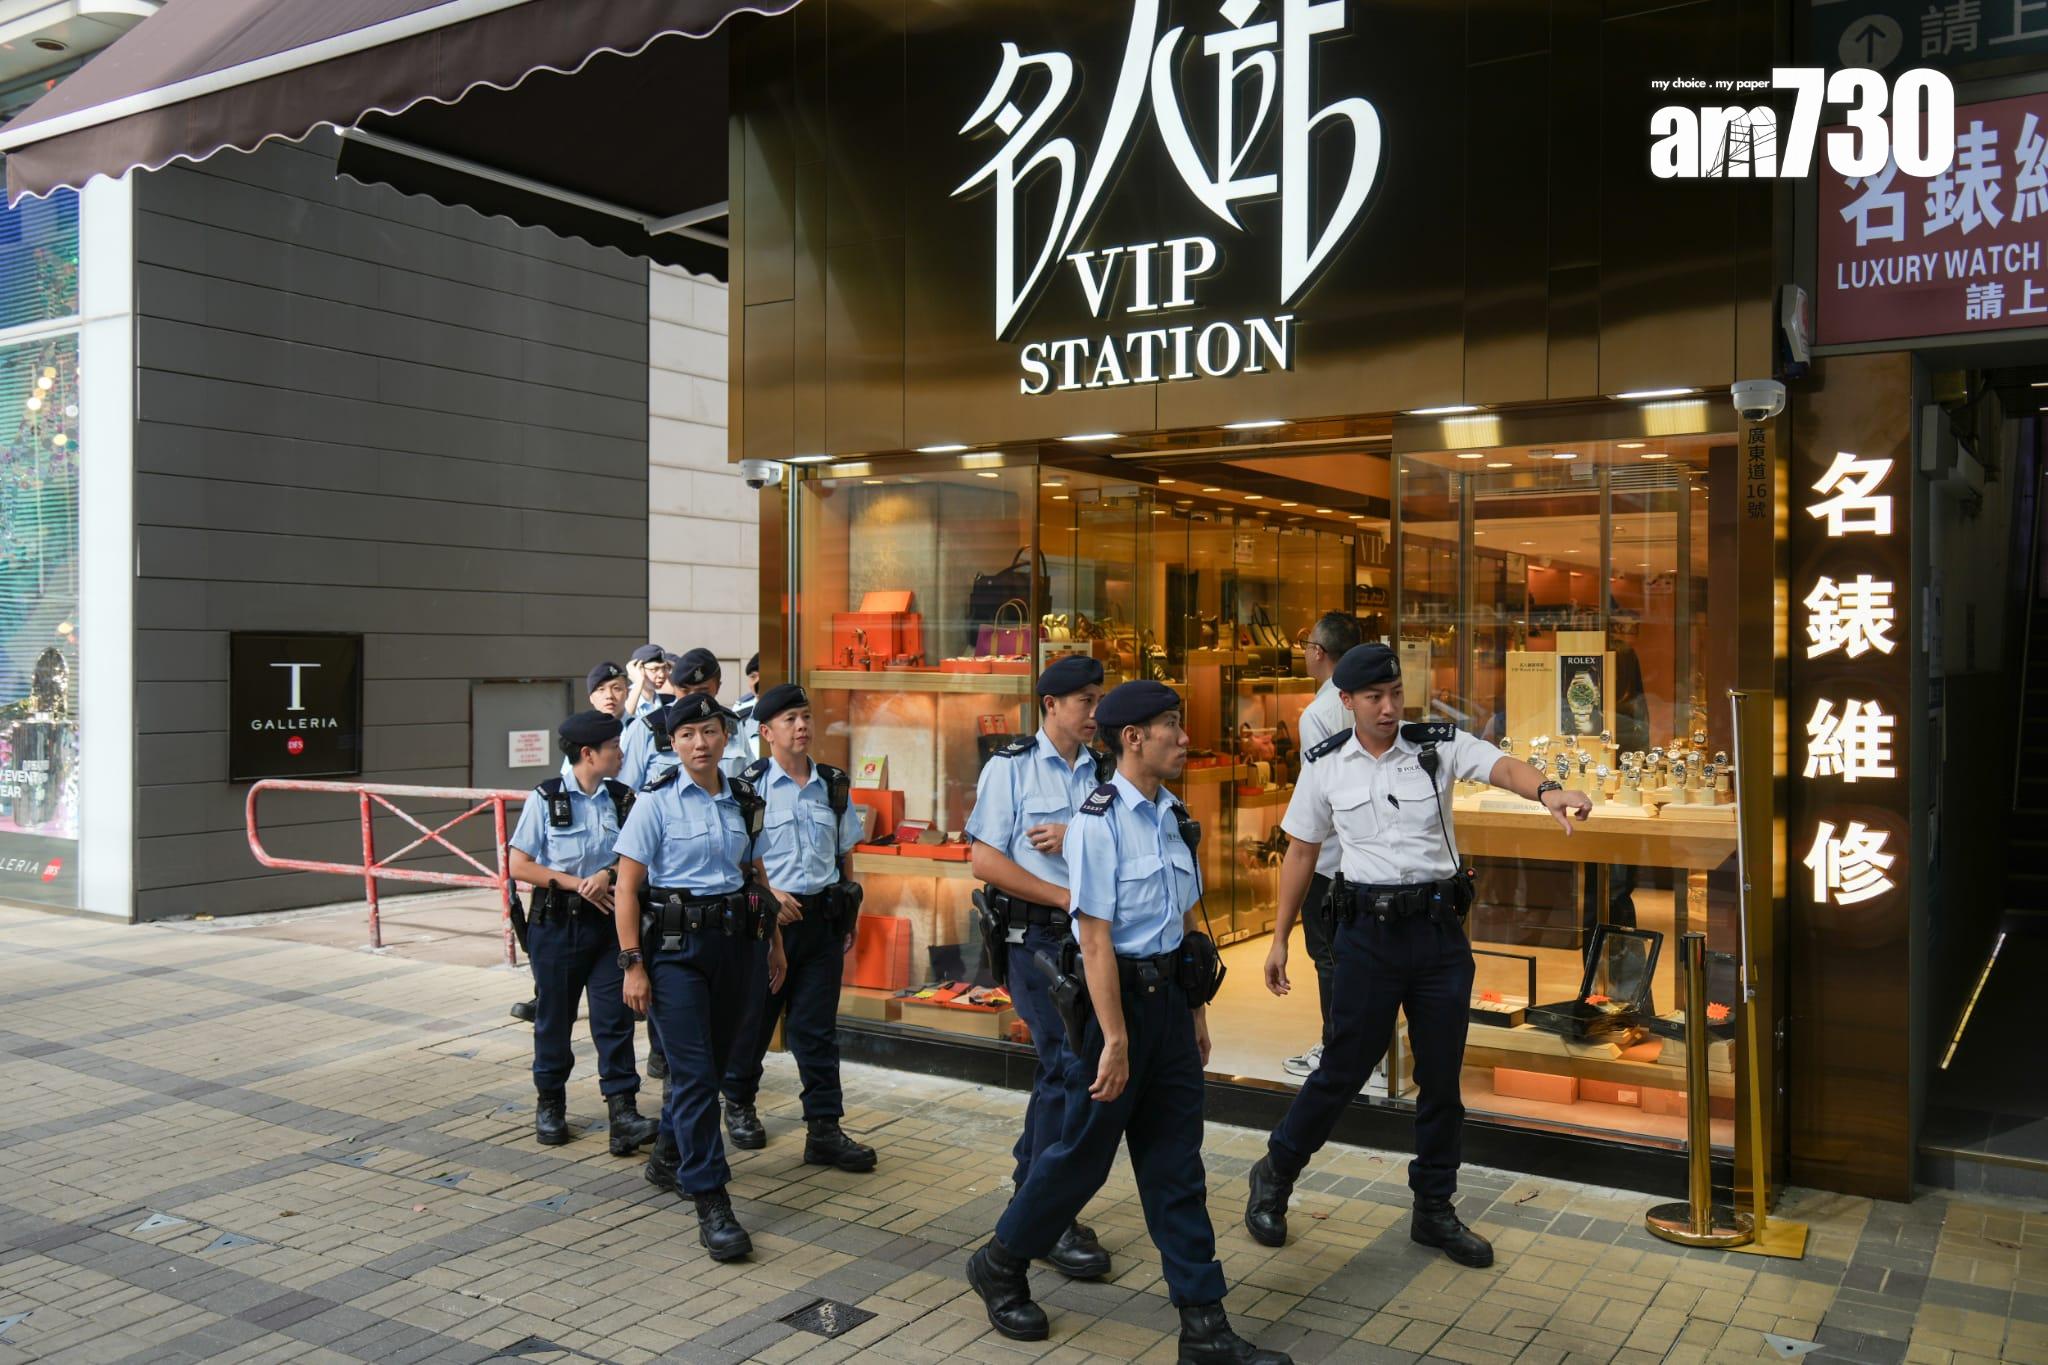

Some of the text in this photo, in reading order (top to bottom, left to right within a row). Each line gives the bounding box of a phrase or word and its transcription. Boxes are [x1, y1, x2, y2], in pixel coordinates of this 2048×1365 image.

[1920, 0, 2048, 59] 請上
[1067, 235, 1216, 318] VIP
[1837, 241, 2040, 290] LUXURY WATCH
[1965, 279, 2048, 321] 請上
[1020, 314, 1295, 394] STATION
[1567, 656, 1596, 665] ROLEX
[1804, 452, 1896, 905] 名錶維修
[270, 663, 321, 711] T
[251, 718, 338, 731] GALLERIA
[288, 741, 304, 749] DFS
